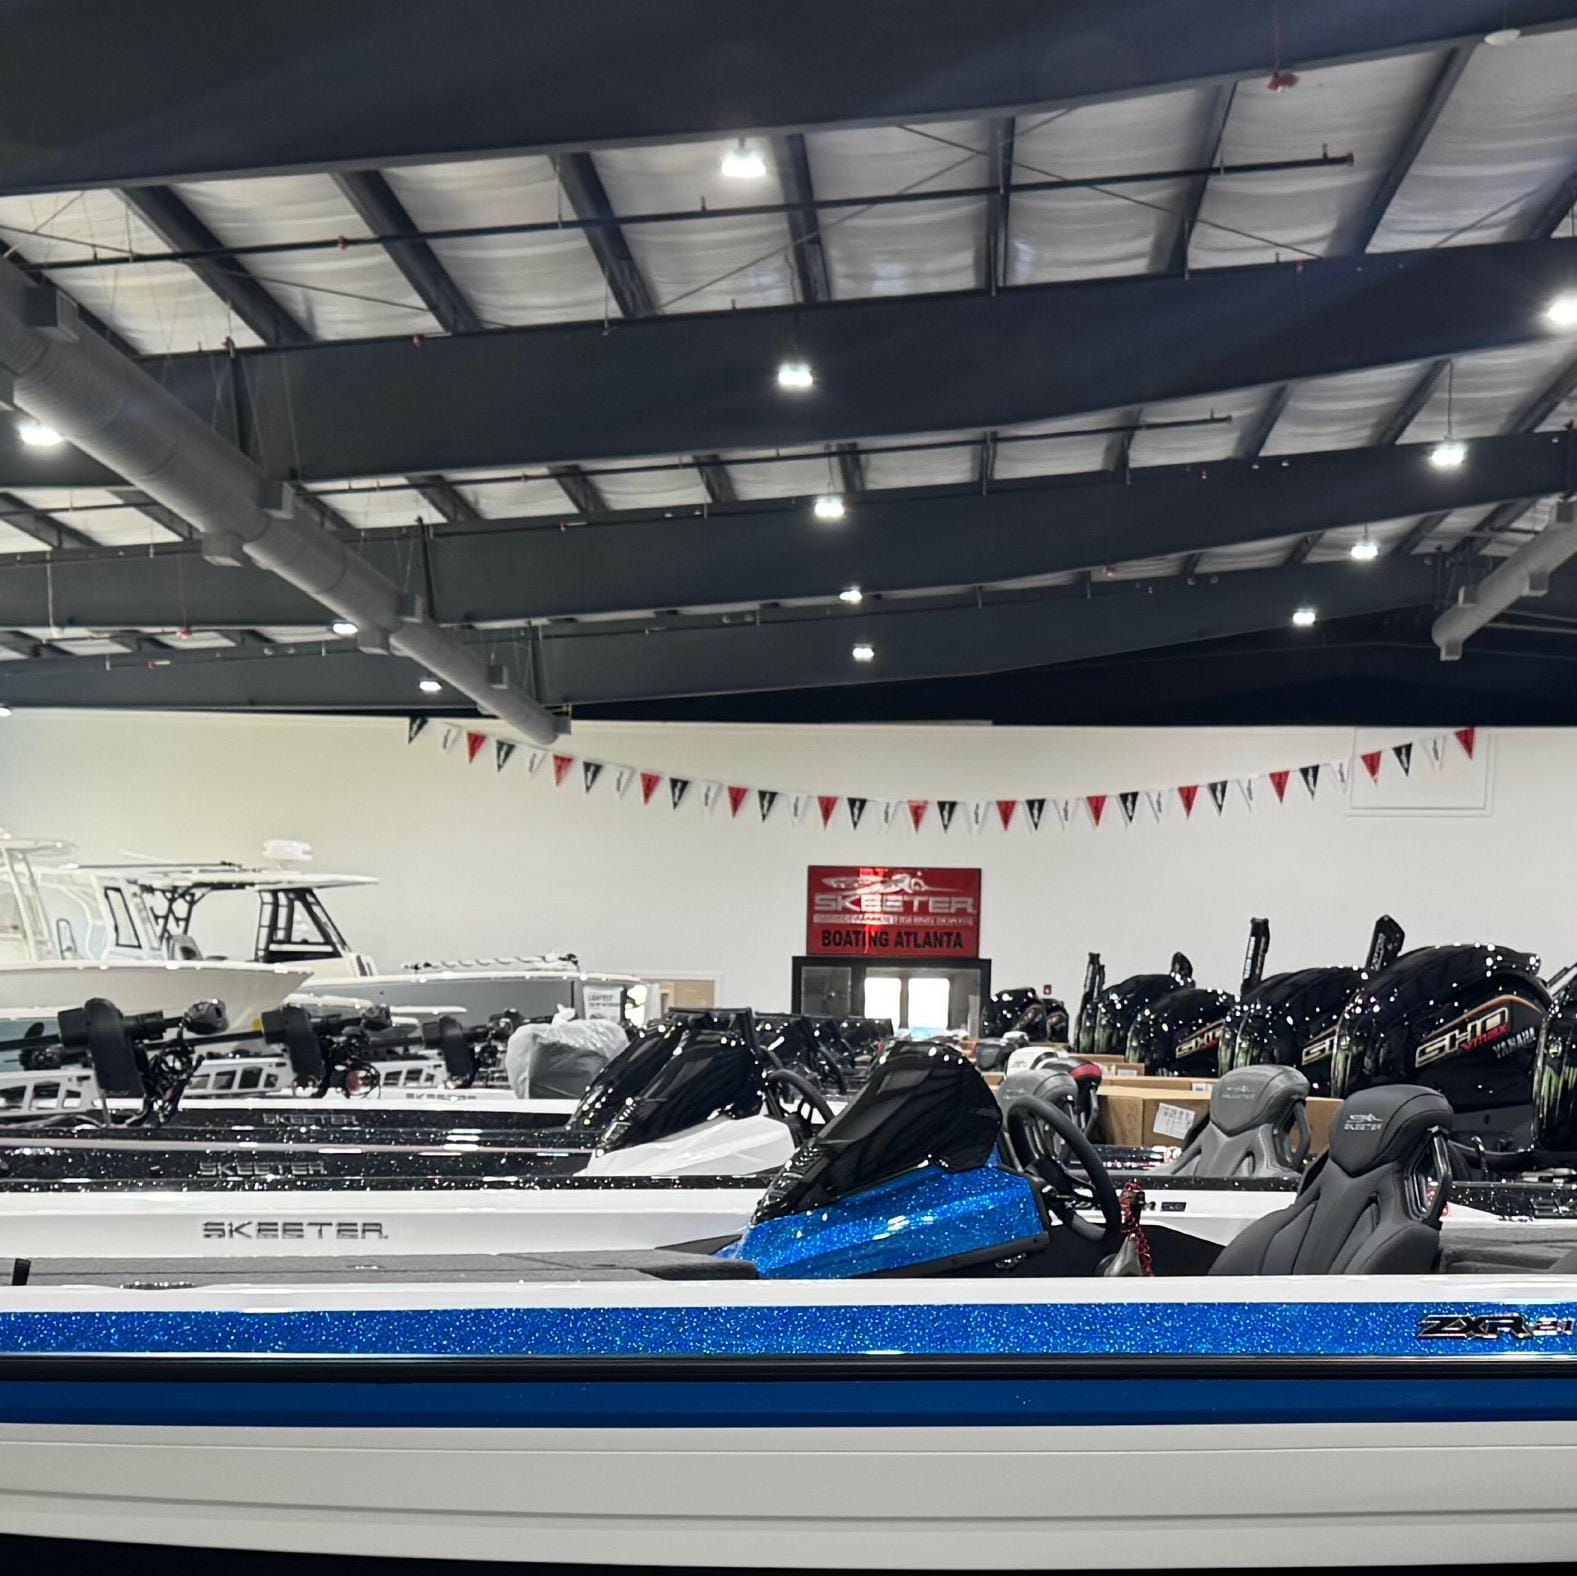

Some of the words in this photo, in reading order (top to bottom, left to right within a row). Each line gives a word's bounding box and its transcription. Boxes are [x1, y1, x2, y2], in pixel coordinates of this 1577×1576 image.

[814, 893, 973, 912] SKEETER
[822, 929, 889, 948] BOATING
[894, 931, 963, 949] ATLANTA
[1415, 1007, 1509, 1068] SHO
[199, 1162, 324, 1176] SKEETER
[203, 1221, 383, 1240] SKEETER
